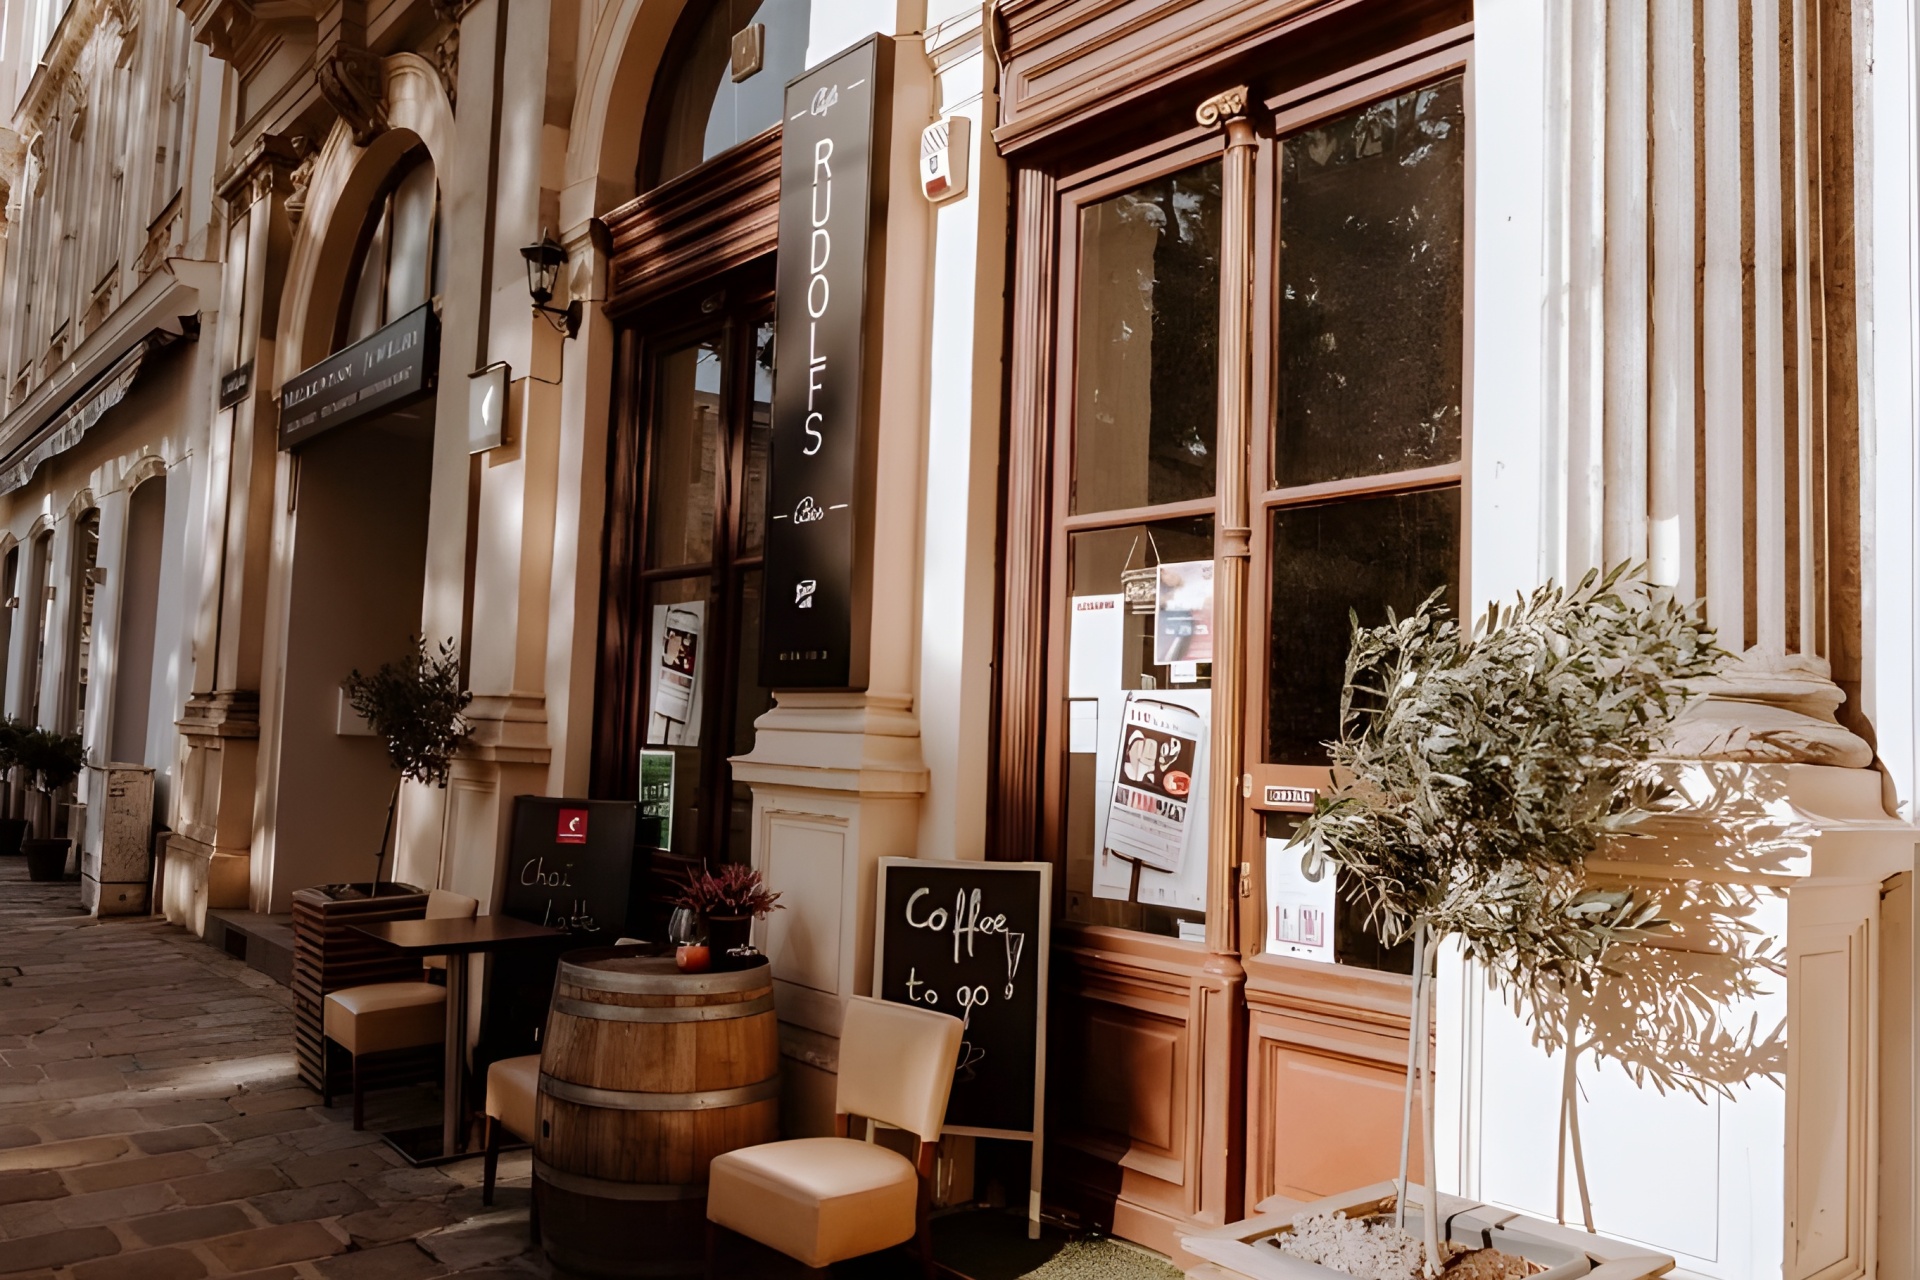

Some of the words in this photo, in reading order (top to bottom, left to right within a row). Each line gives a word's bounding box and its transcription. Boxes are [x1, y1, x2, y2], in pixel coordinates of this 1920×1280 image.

[802, 138, 834, 456] RUDOLFS
[905, 887, 1008, 964] Coffee
[905, 967, 939, 1004] to
